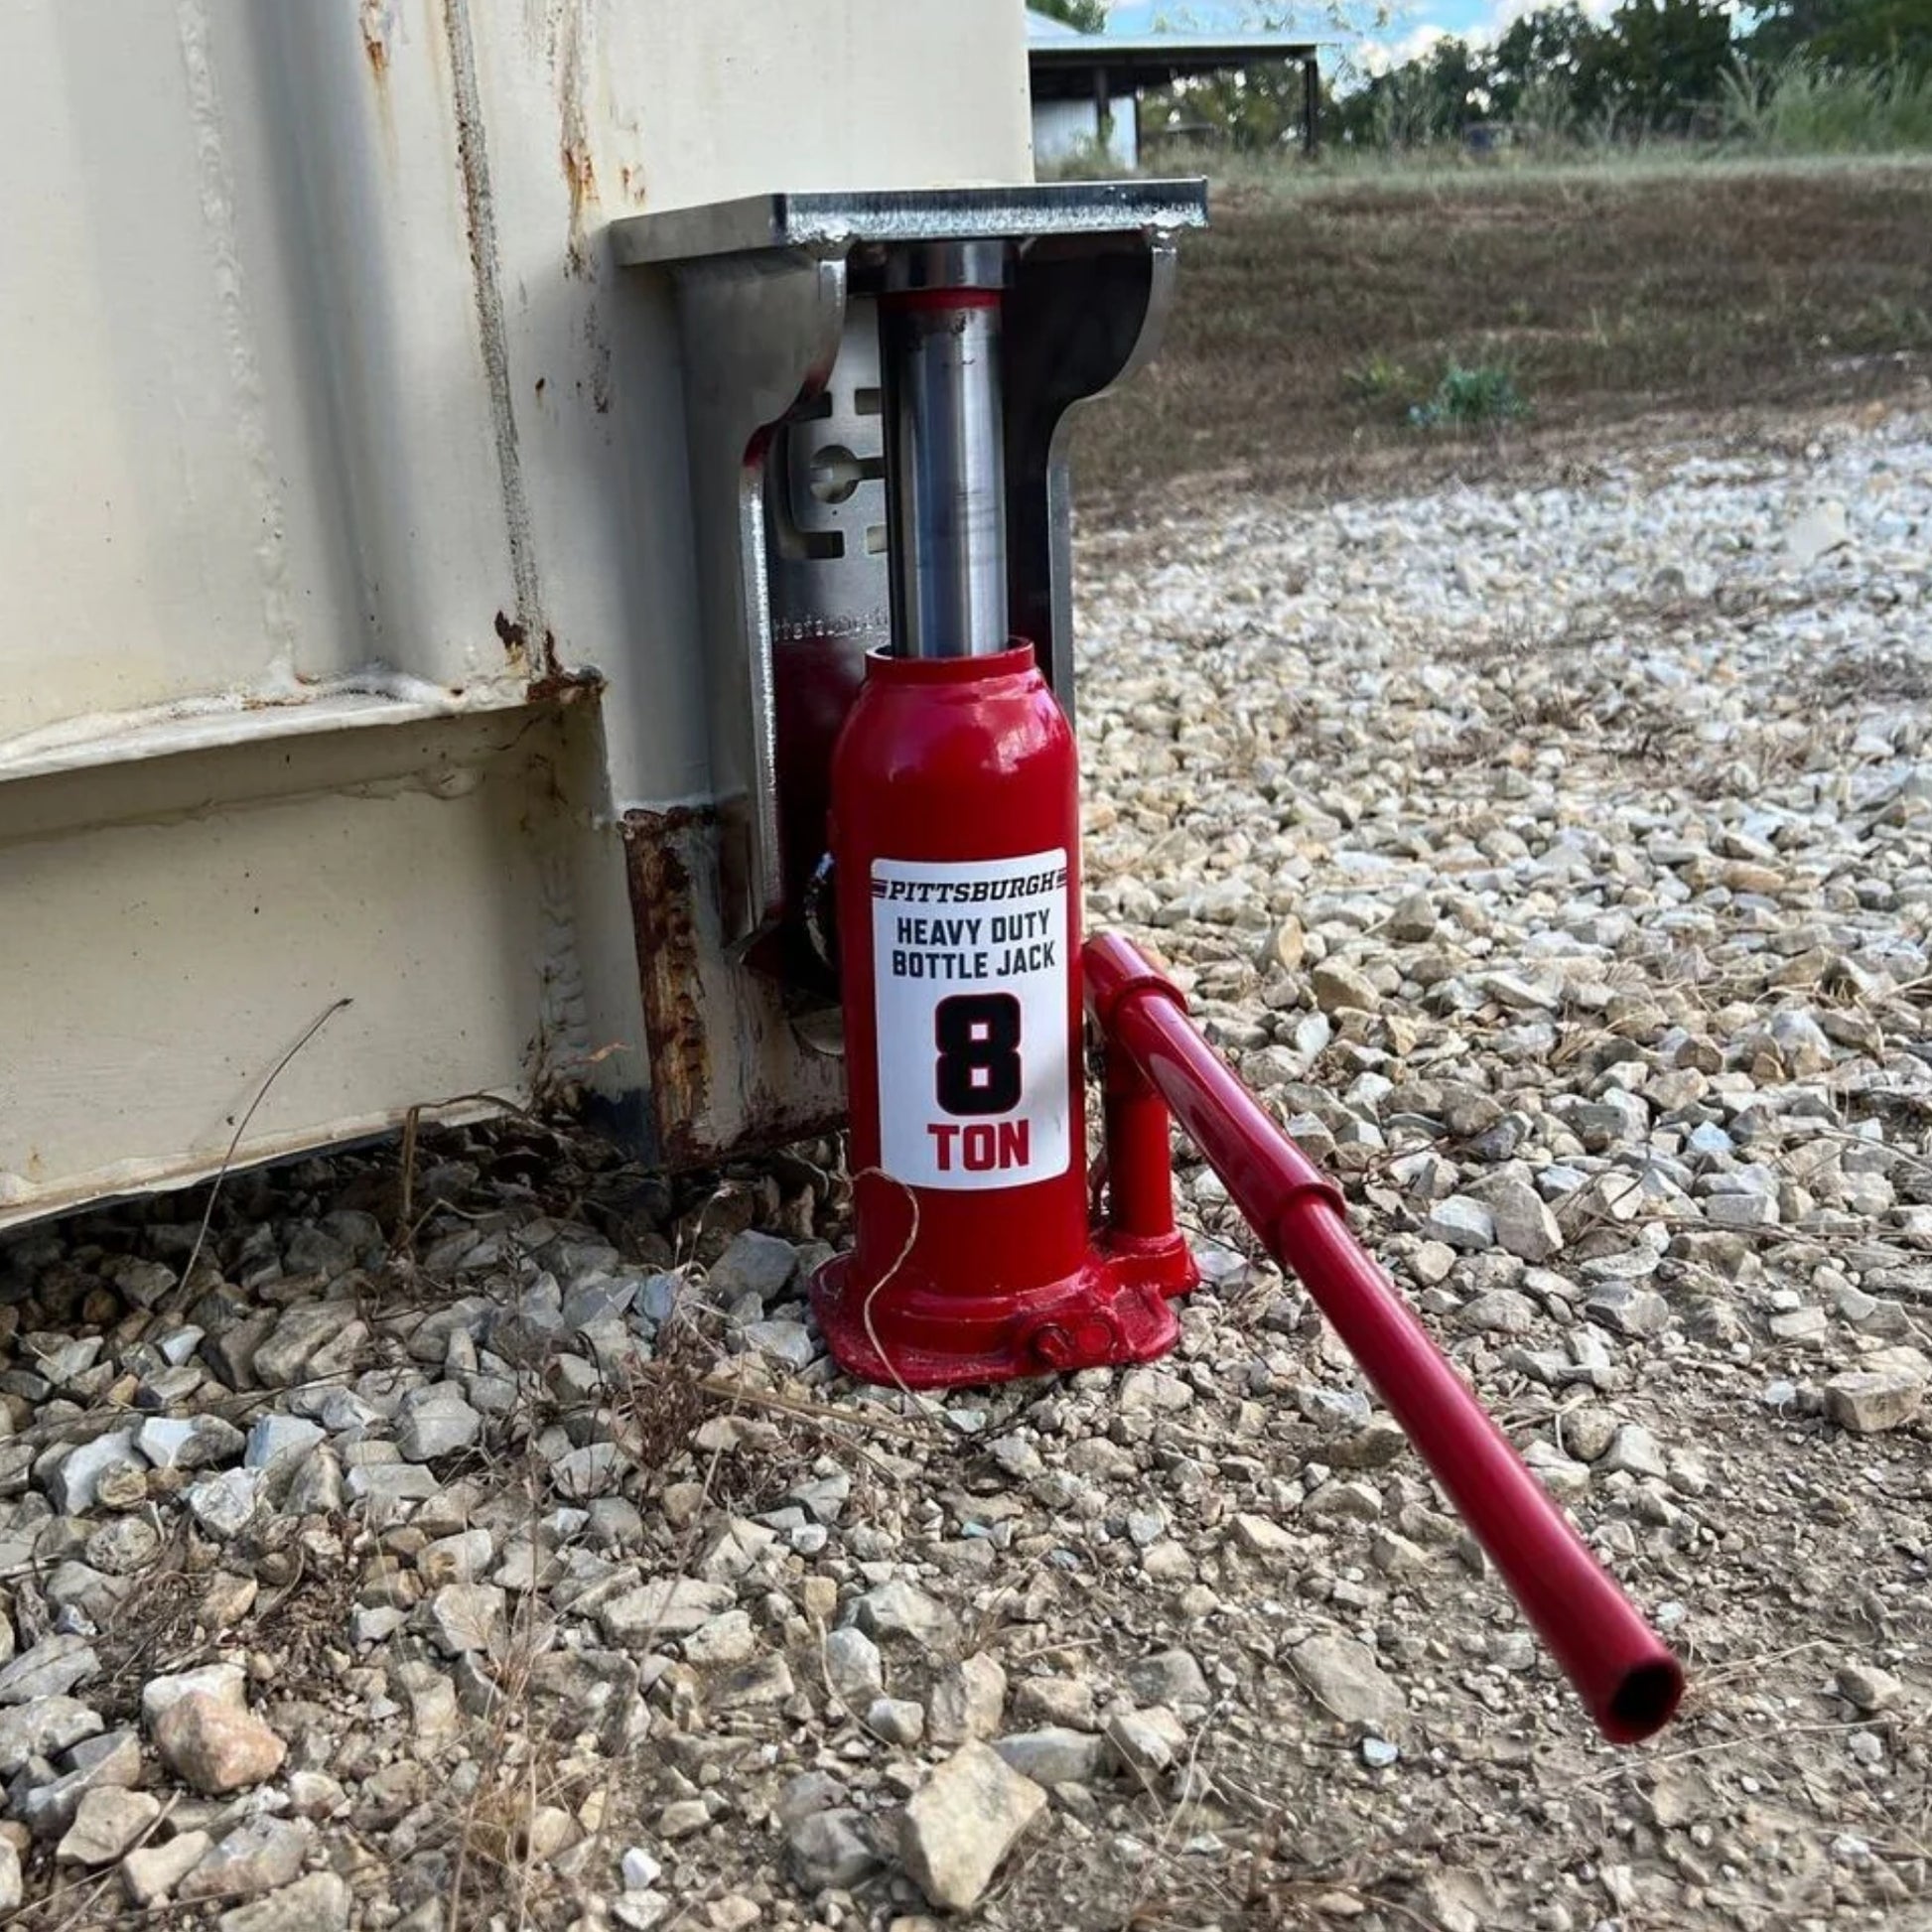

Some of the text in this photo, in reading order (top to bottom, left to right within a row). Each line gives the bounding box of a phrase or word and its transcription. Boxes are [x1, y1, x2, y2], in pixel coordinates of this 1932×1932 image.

[889, 870, 1056, 902] PITTSBURGH
[897, 907, 1050, 946] HEAVY DUTY
[893, 941, 1055, 979] BOTTLE JACK
[935, 993, 1022, 1116] 8
[926, 1119, 1029, 1171] TON
